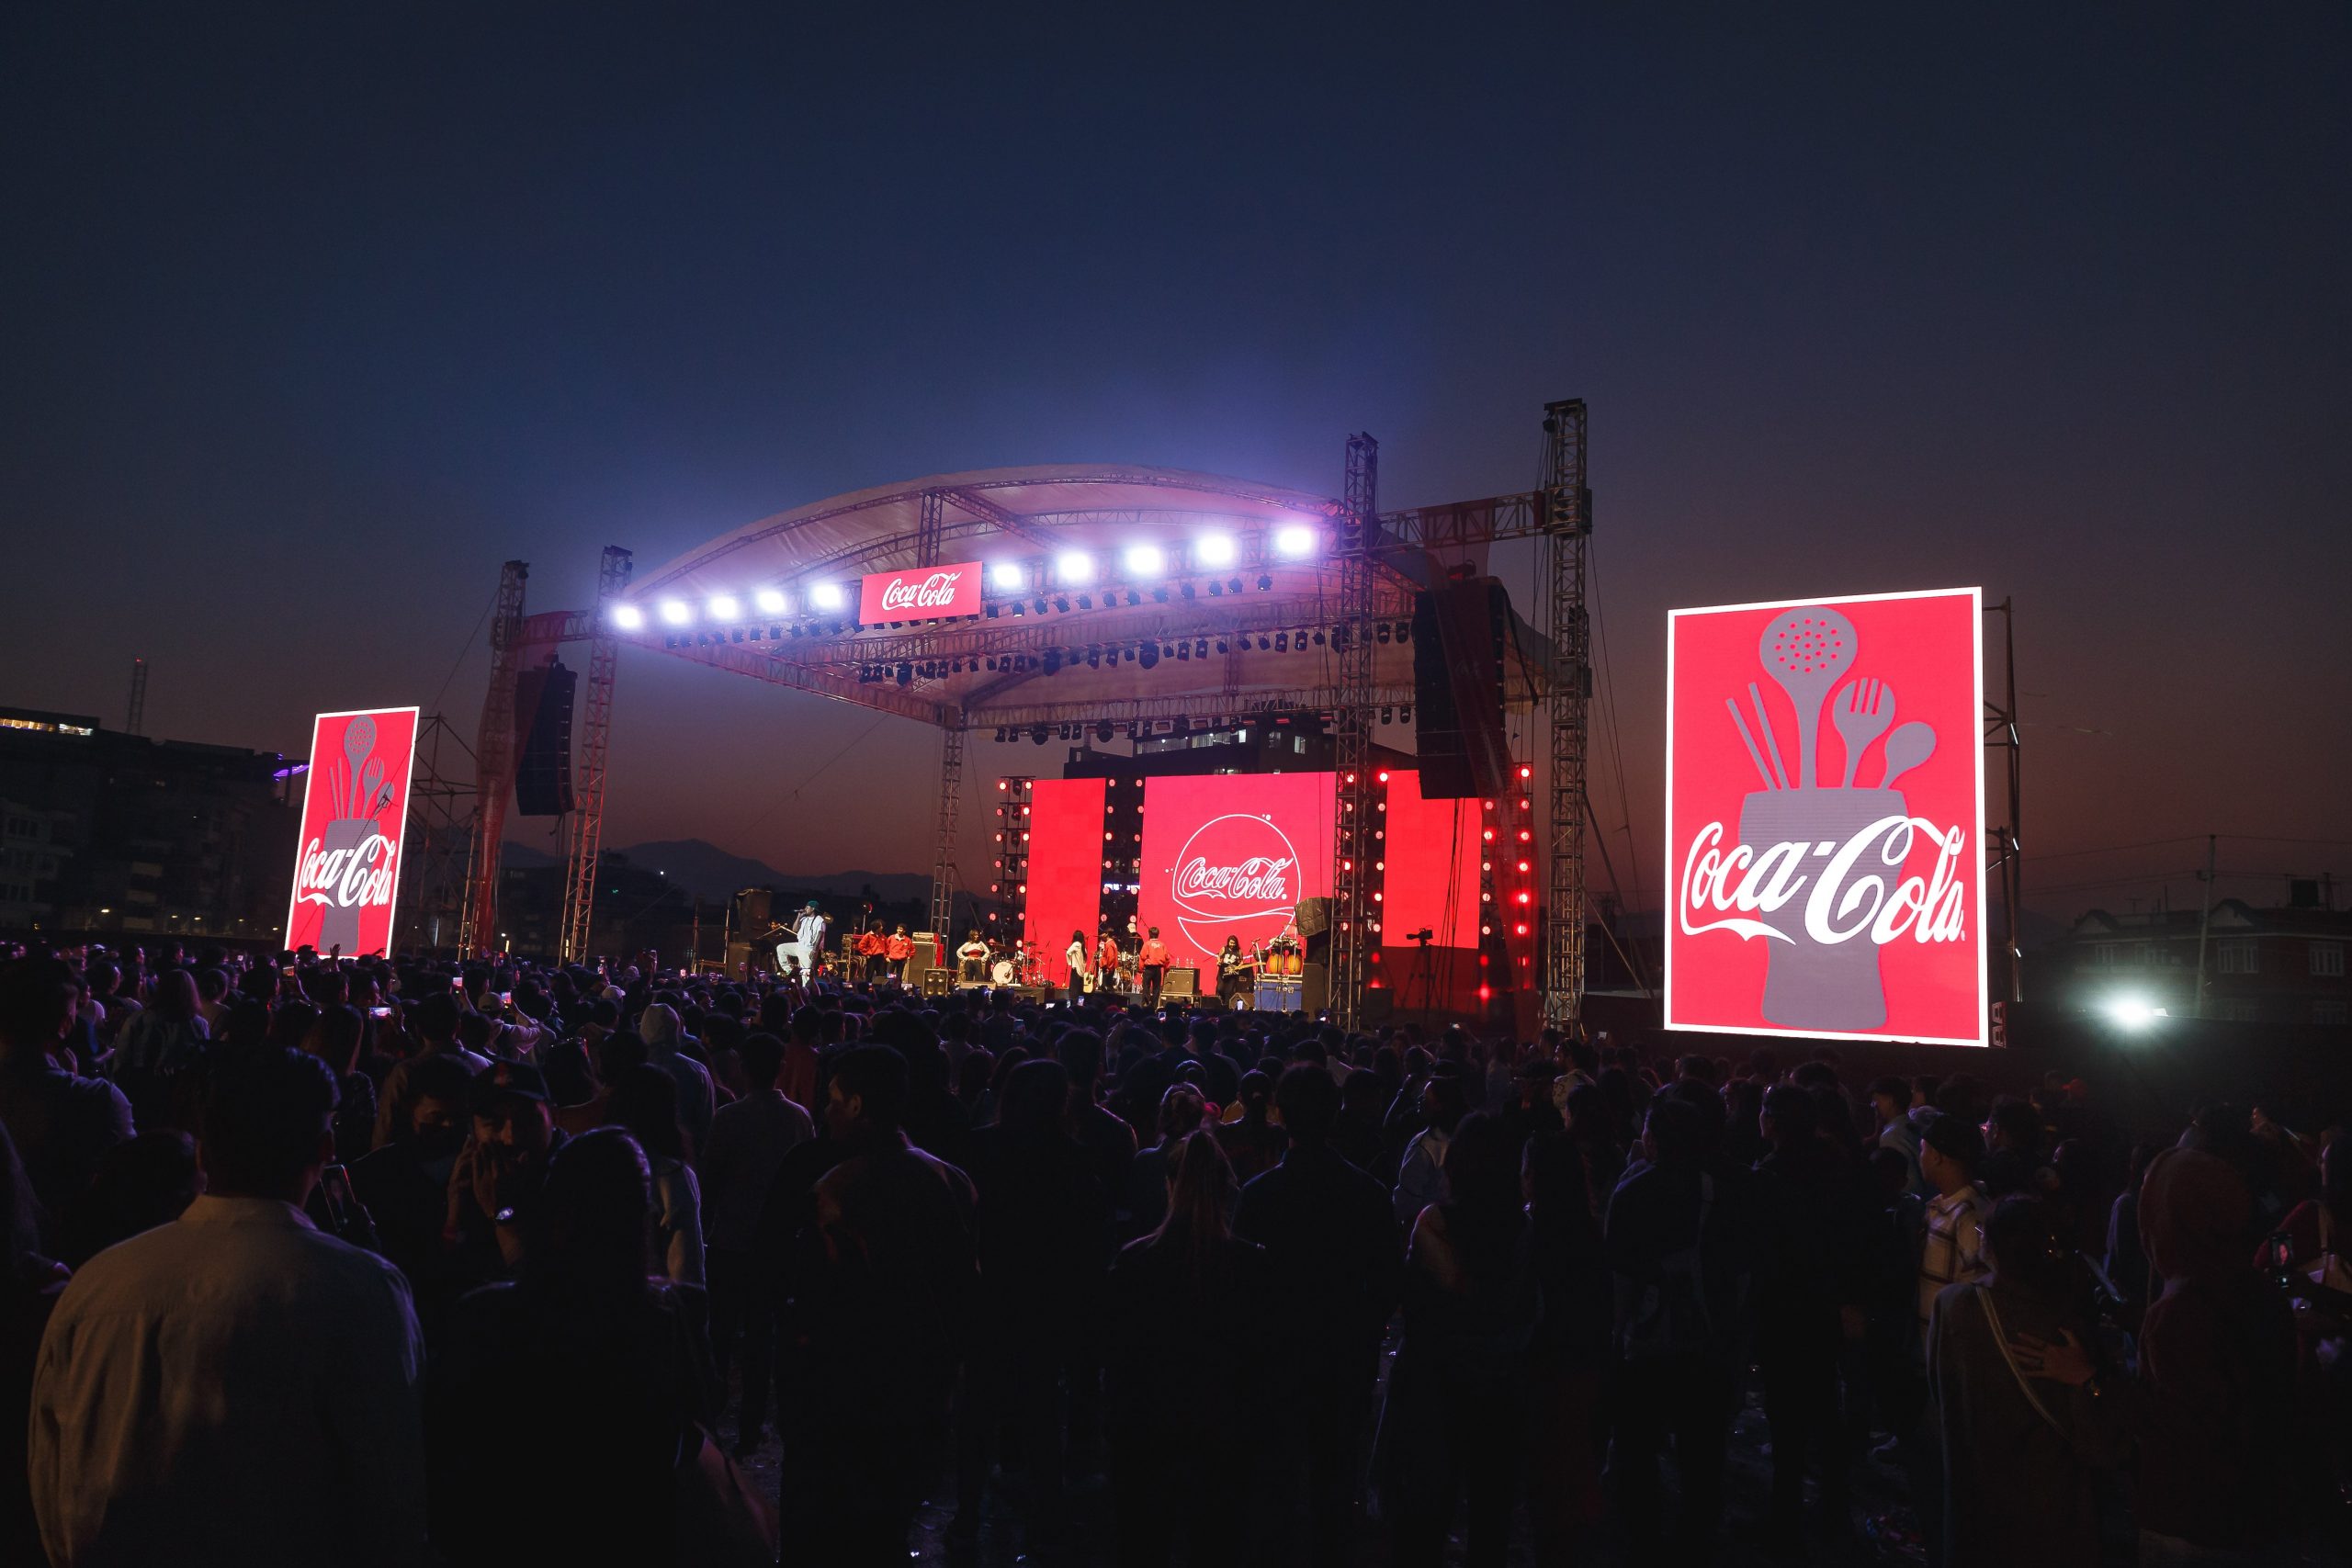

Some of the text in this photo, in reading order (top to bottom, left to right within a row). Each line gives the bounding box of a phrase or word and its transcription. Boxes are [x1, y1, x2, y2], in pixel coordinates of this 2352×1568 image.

[882, 571, 963, 611] Coca-Cola
[1177, 856, 1294, 900] Coca-Cola
[1680, 815, 1965, 945] Coca-Cola
